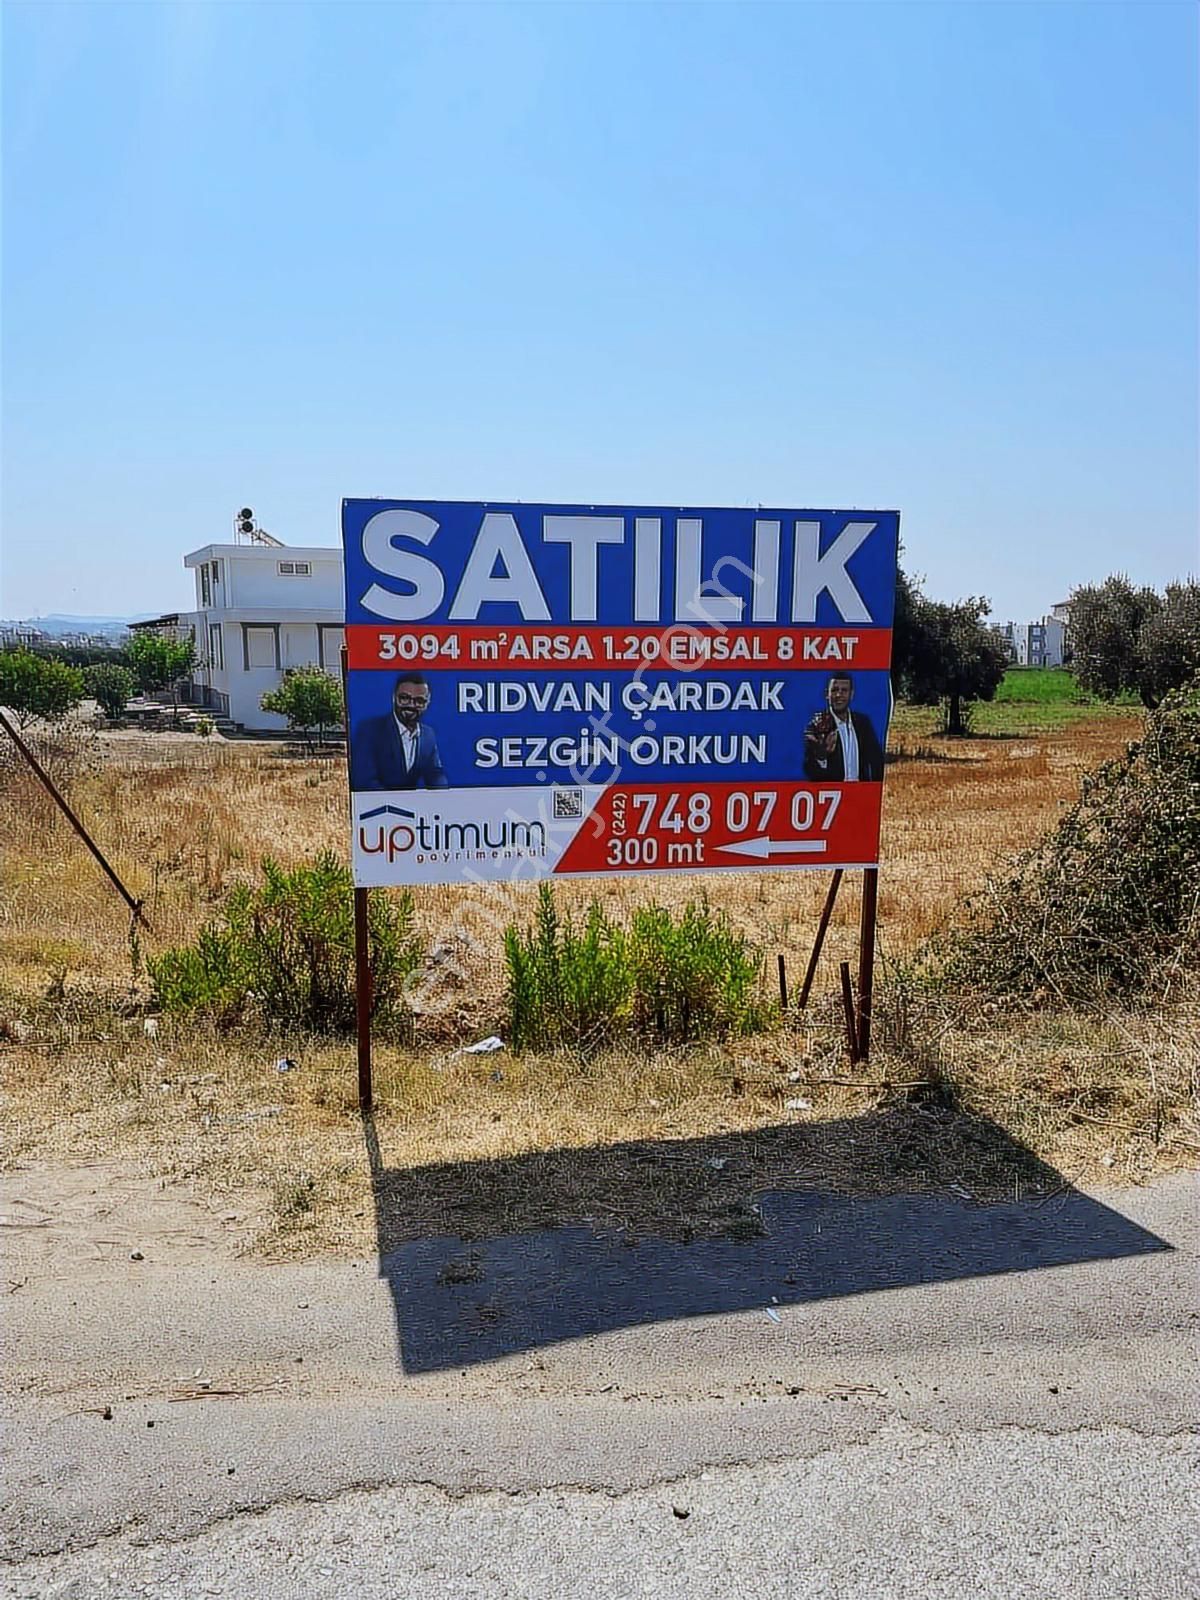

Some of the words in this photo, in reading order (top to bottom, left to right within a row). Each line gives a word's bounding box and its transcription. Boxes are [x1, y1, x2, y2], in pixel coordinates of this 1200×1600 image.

[359, 508, 878, 624] SATILIK
[378, 634, 461, 660] 3094
[602, 635, 661, 660] 1.20
[670, 636, 768, 660] EMSAL
[777, 636, 794, 661] 8
[802, 636, 859, 661] KAT
[457, 681, 611, 713] RIDVAN
[622, 681, 785, 721] ÇARDAK
[474, 727, 619, 767] SEZGİN
[629, 734, 767, 765] ORKUN
[611, 792, 628, 836] (242)
[632, 792, 711, 835] 748
[726, 790, 778, 833] 07
[791, 789, 842, 831] 07
[359, 813, 546, 864] uptimum
[606, 837, 658, 866] 300
[667, 837, 705, 864] mt
